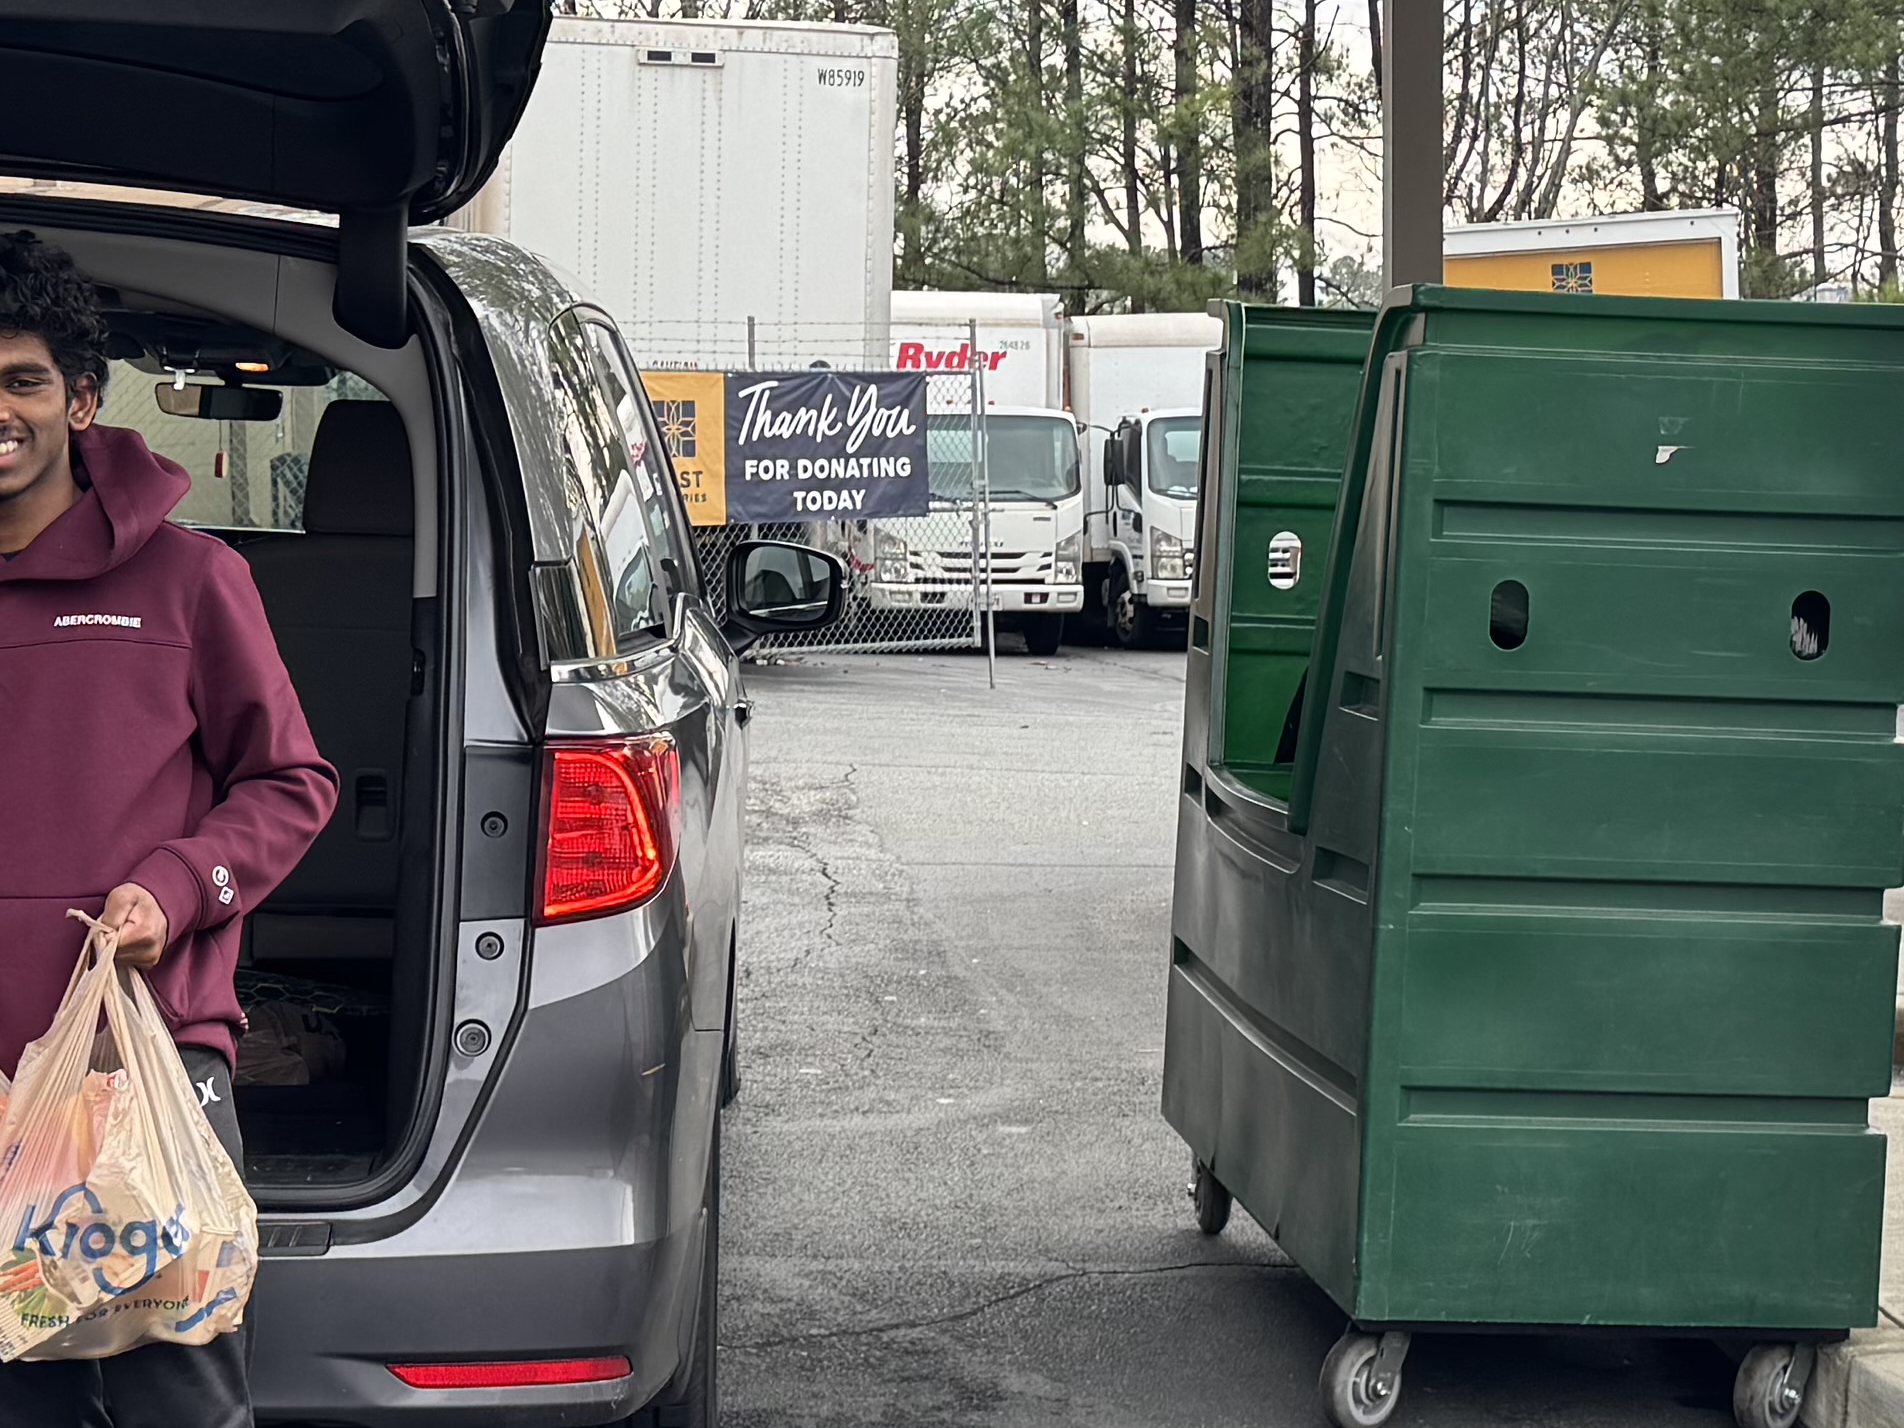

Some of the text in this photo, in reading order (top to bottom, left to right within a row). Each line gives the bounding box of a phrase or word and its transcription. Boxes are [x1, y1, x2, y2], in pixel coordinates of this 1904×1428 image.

[818, 69, 864, 87] W85919
[896, 343, 1007, 370] Ryder
[739, 381, 916, 454] Thank You
[680, 471, 703, 488] ST
[745, 457, 911, 480] FOR DONATING
[793, 490, 865, 511] TODAY
[54, 614, 141, 628] ABERCROMBIE
[21, 1313, 69, 1329] FRESH
[77, 1306, 107, 1323] FOR
